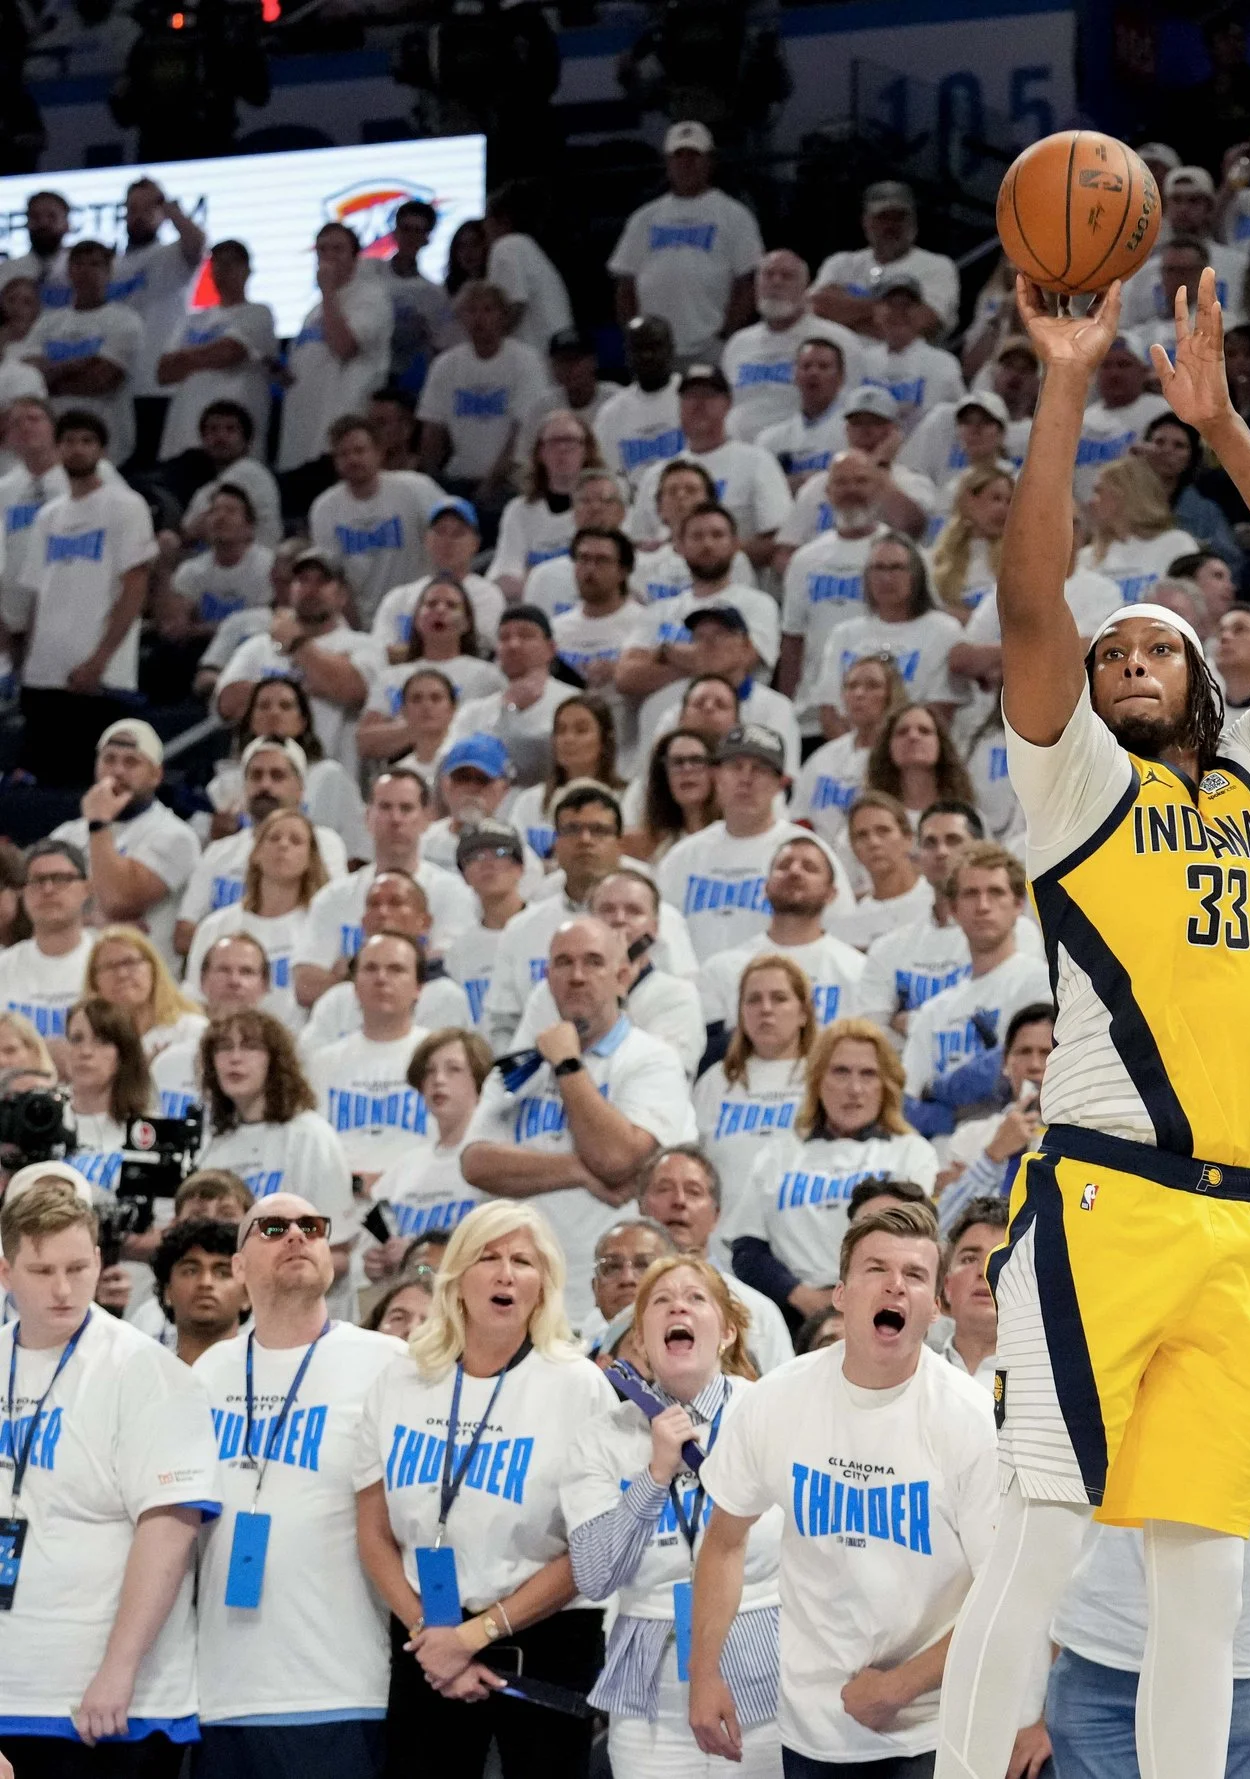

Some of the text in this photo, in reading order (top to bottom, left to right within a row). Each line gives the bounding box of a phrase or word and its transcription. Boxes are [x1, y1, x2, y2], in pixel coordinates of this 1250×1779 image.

[1186, 863, 1250, 950] 33
[715, 1102, 794, 1141] THUND
[843, 1469, 870, 1482] CITY
